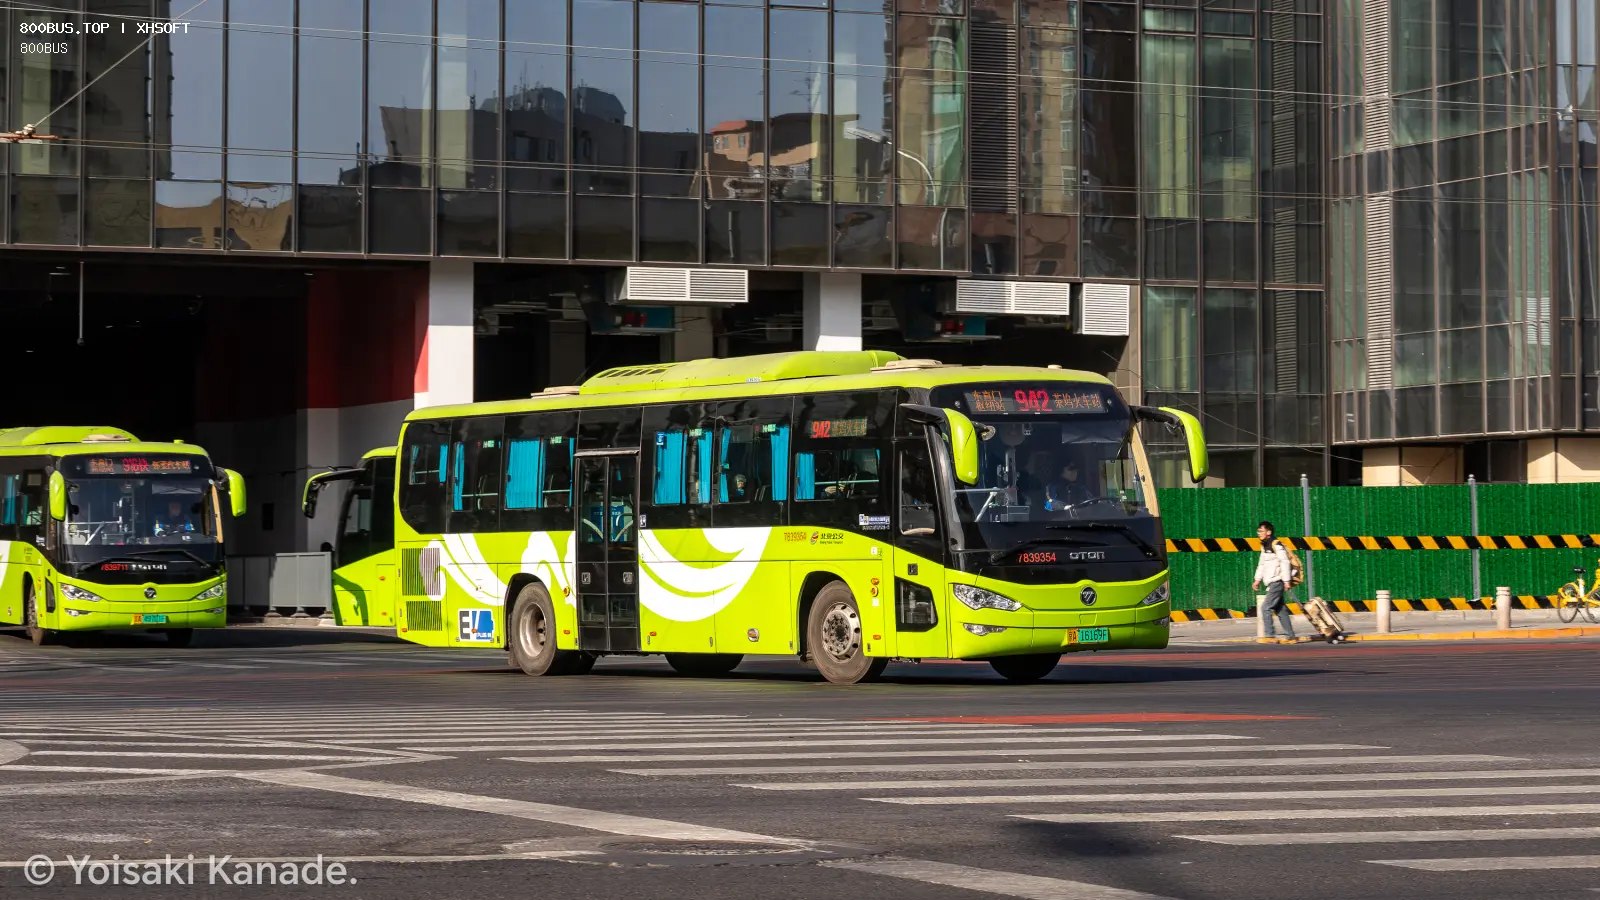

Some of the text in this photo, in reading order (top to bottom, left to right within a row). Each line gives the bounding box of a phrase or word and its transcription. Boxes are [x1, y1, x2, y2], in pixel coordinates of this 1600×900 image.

[1014, 389, 1053, 411] 942
[812, 420, 831, 438] 942
[1018, 551, 1057, 563] 7839354
